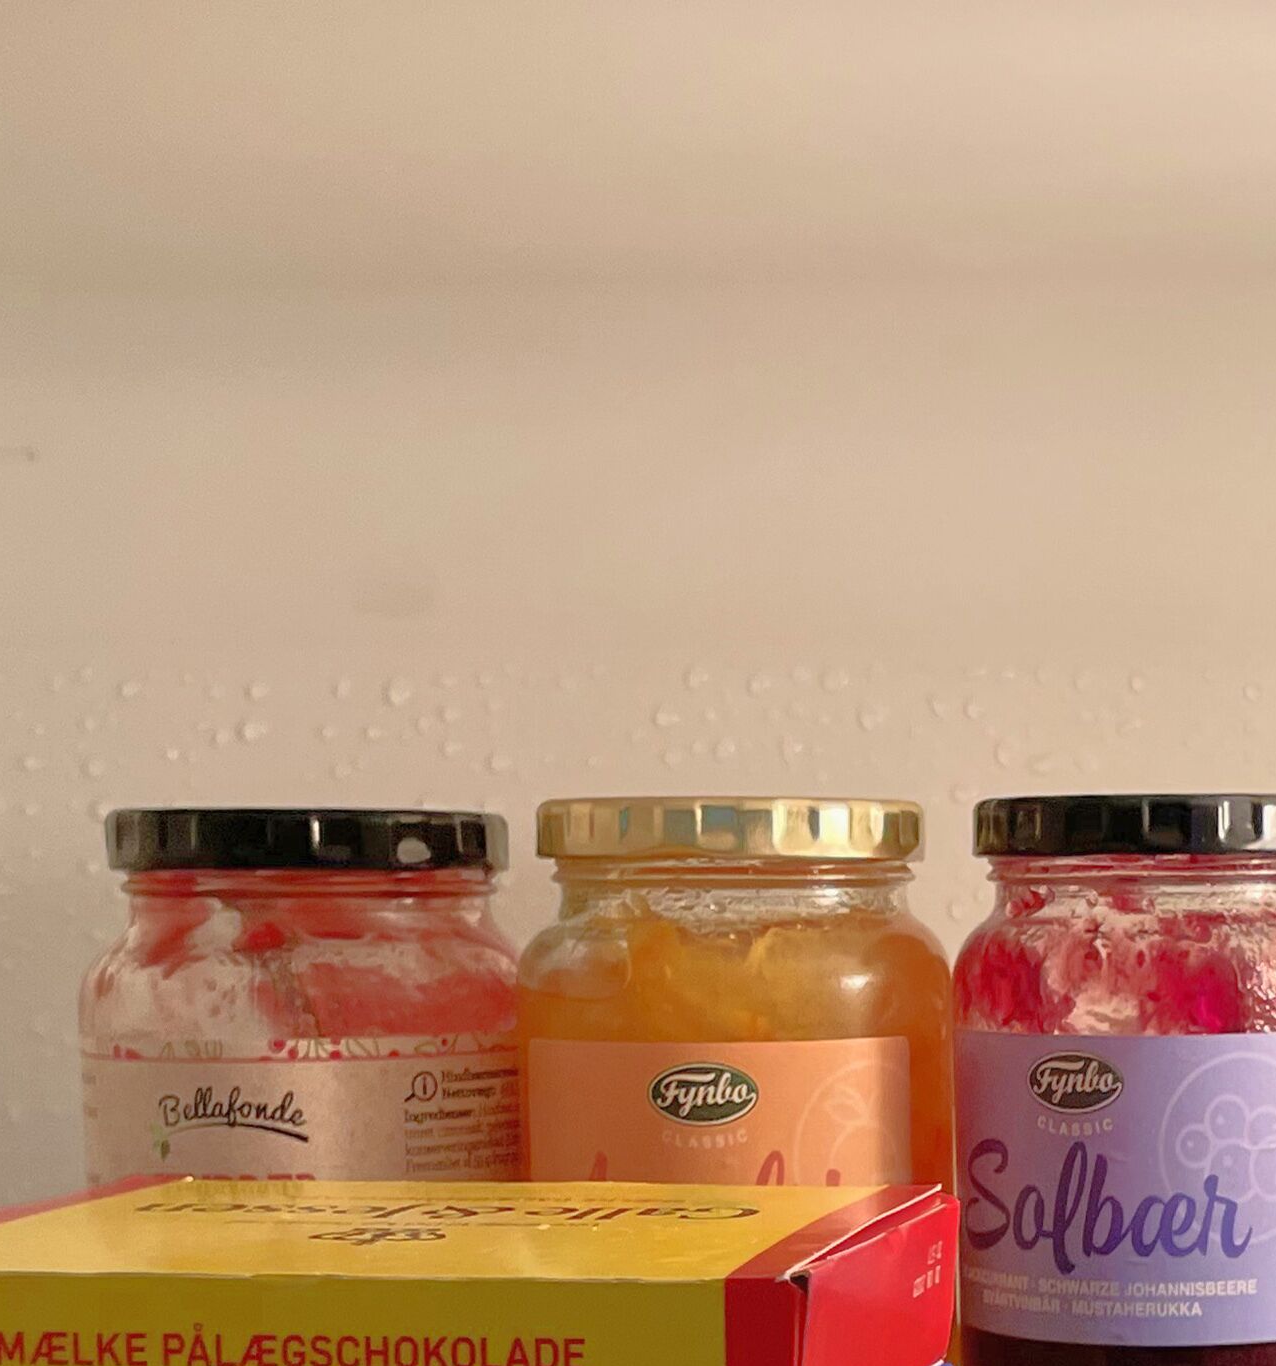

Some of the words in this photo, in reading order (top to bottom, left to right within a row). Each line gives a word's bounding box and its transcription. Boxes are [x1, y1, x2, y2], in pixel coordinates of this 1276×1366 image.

[656, 1069, 758, 1117] Fynbo
[1032, 1056, 1122, 1104] Fynbo
[159, 1085, 308, 1127] Bellafonde
[1036, 1116, 1115, 1137] CLASSIC
[965, 1138, 1254, 1275] Solbær
[1037, 1277, 1120, 1297] SCHWARZE
[1125, 1277, 1258, 1297] JOHANNISBEERE
[1072, 1299, 1203, 1317] MUSTAHERUKKA
